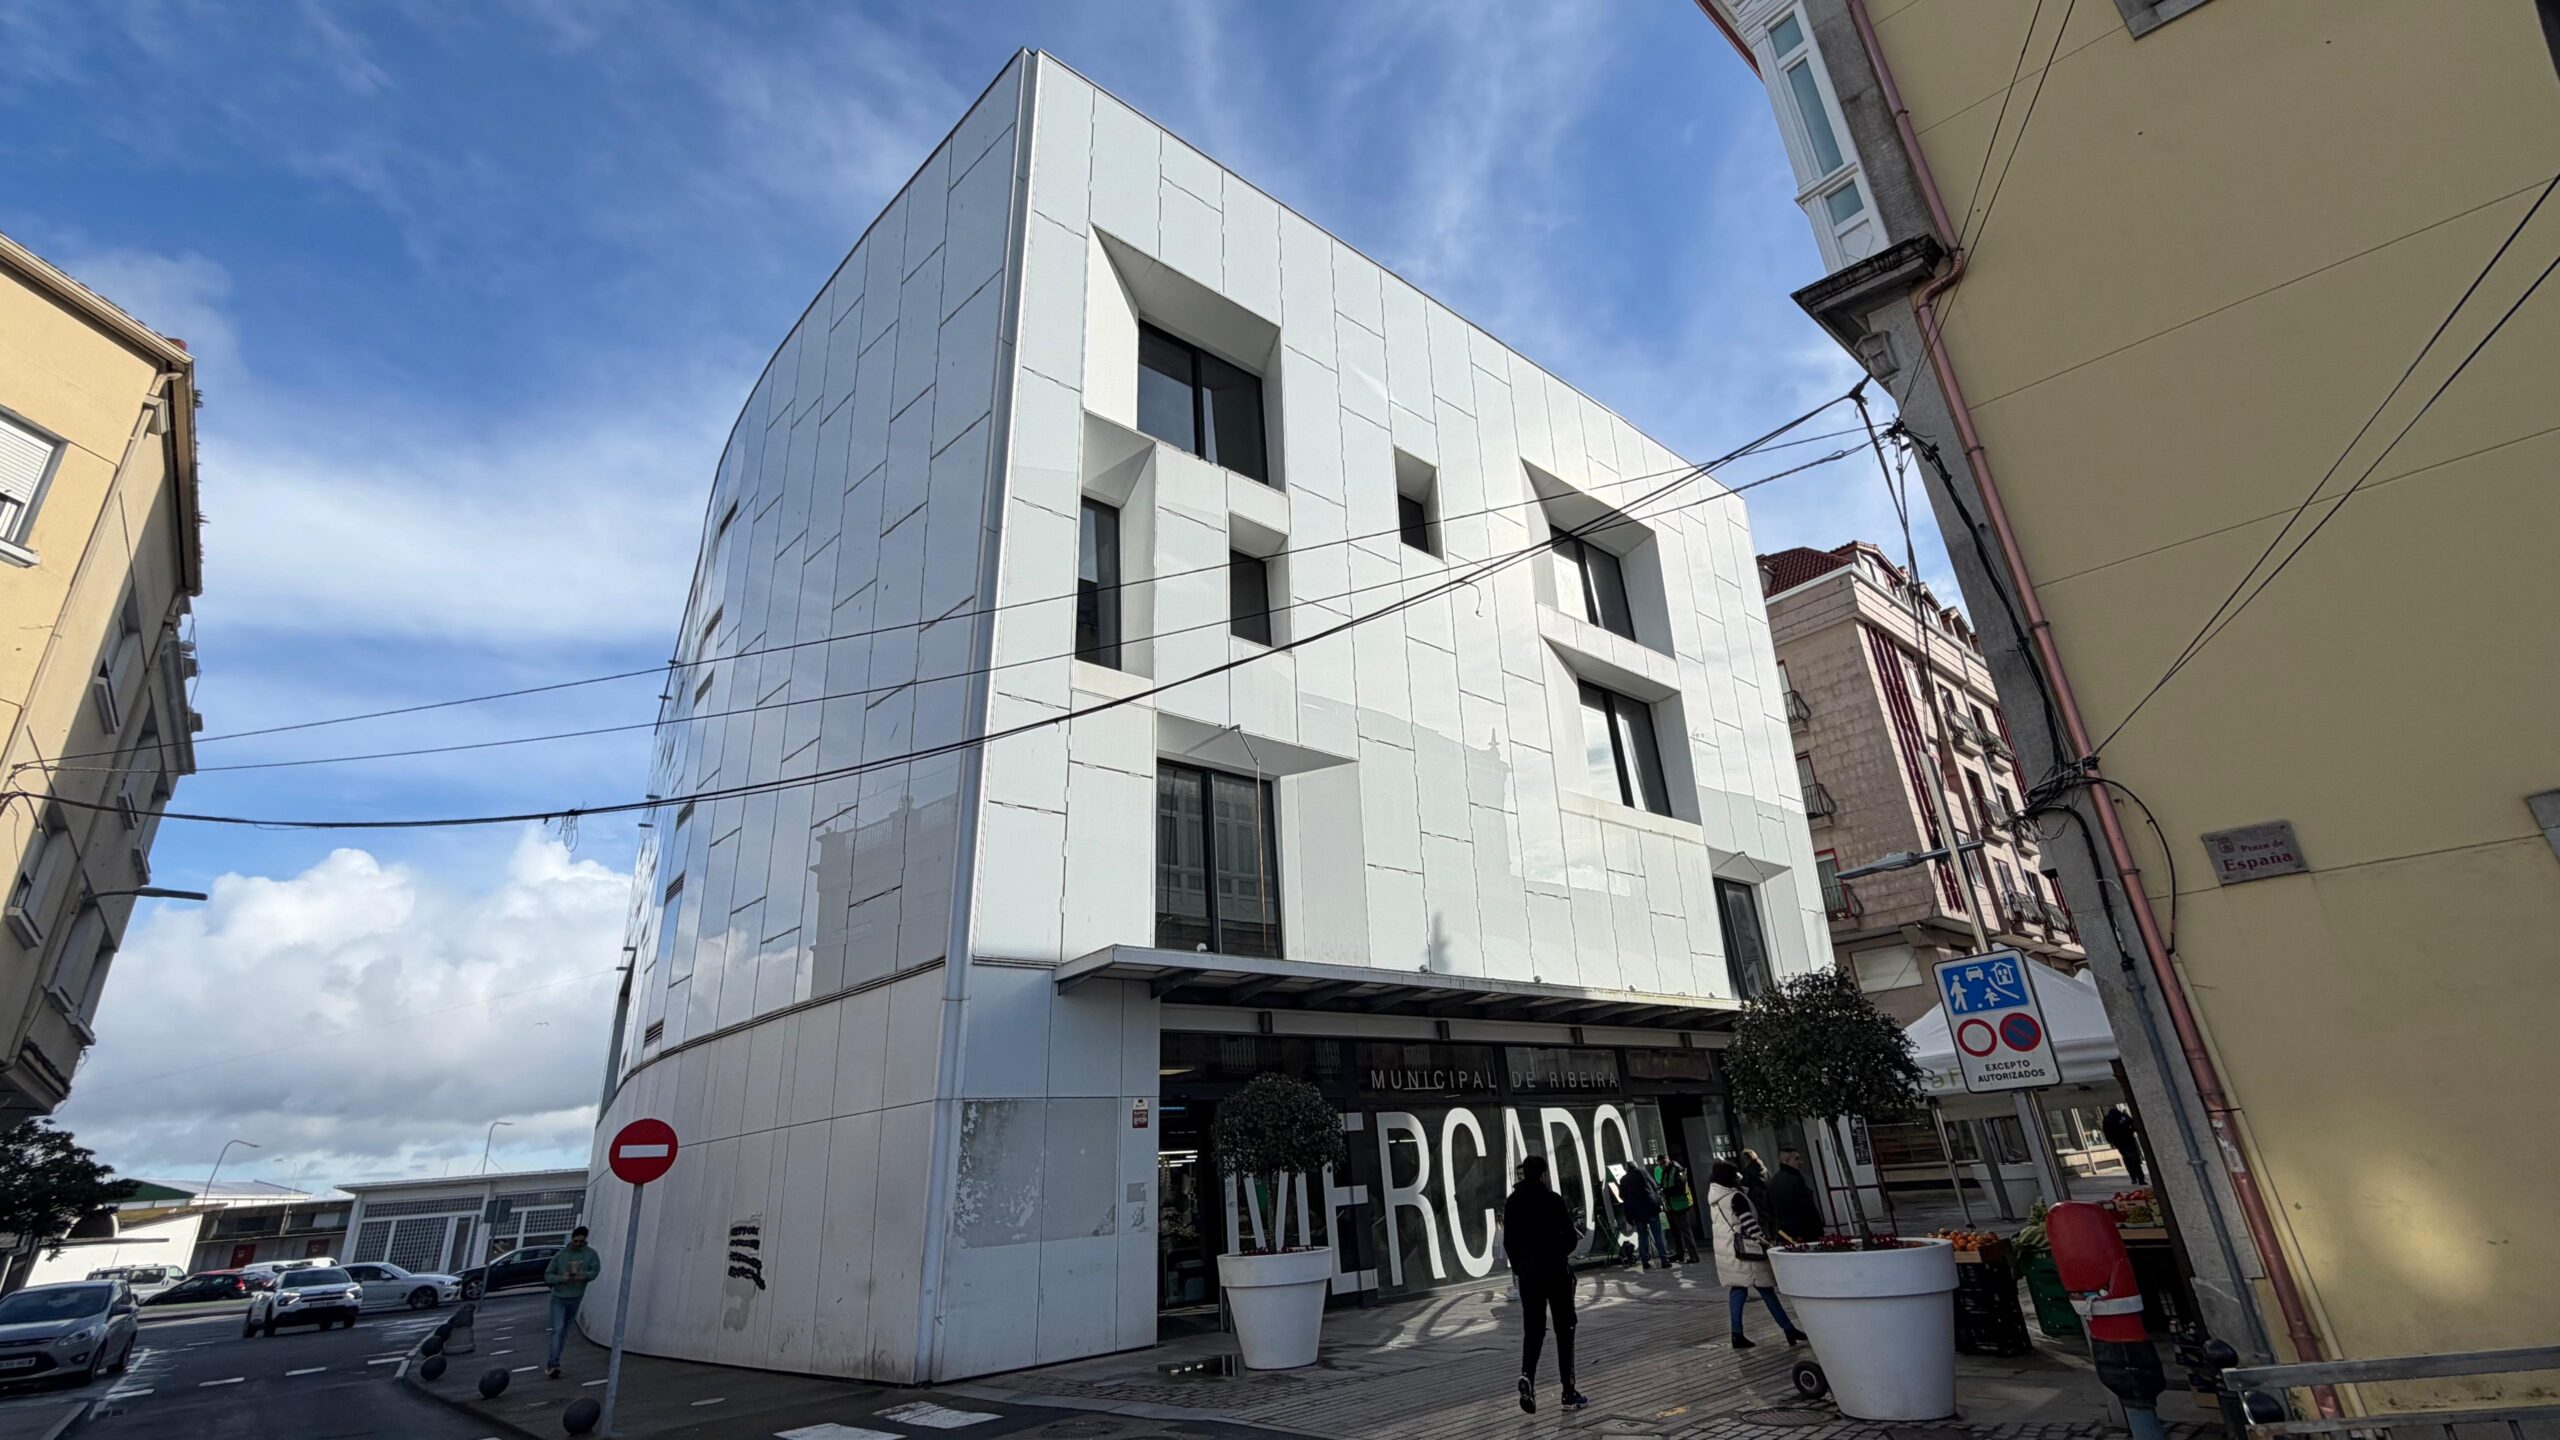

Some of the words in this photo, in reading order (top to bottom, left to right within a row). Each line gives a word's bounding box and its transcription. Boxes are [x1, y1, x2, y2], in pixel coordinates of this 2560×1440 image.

[2223, 851, 2293, 872] España
[1985, 1060, 2031, 1072] EXCEPTO
[1370, 1070, 1497, 1090] MUNICIPAL
[1511, 1071, 1537, 1088] DE
[1550, 1071, 1619, 1089] RIBEIRA
[1978, 1068, 2046, 1083] AUTORIZADOS
